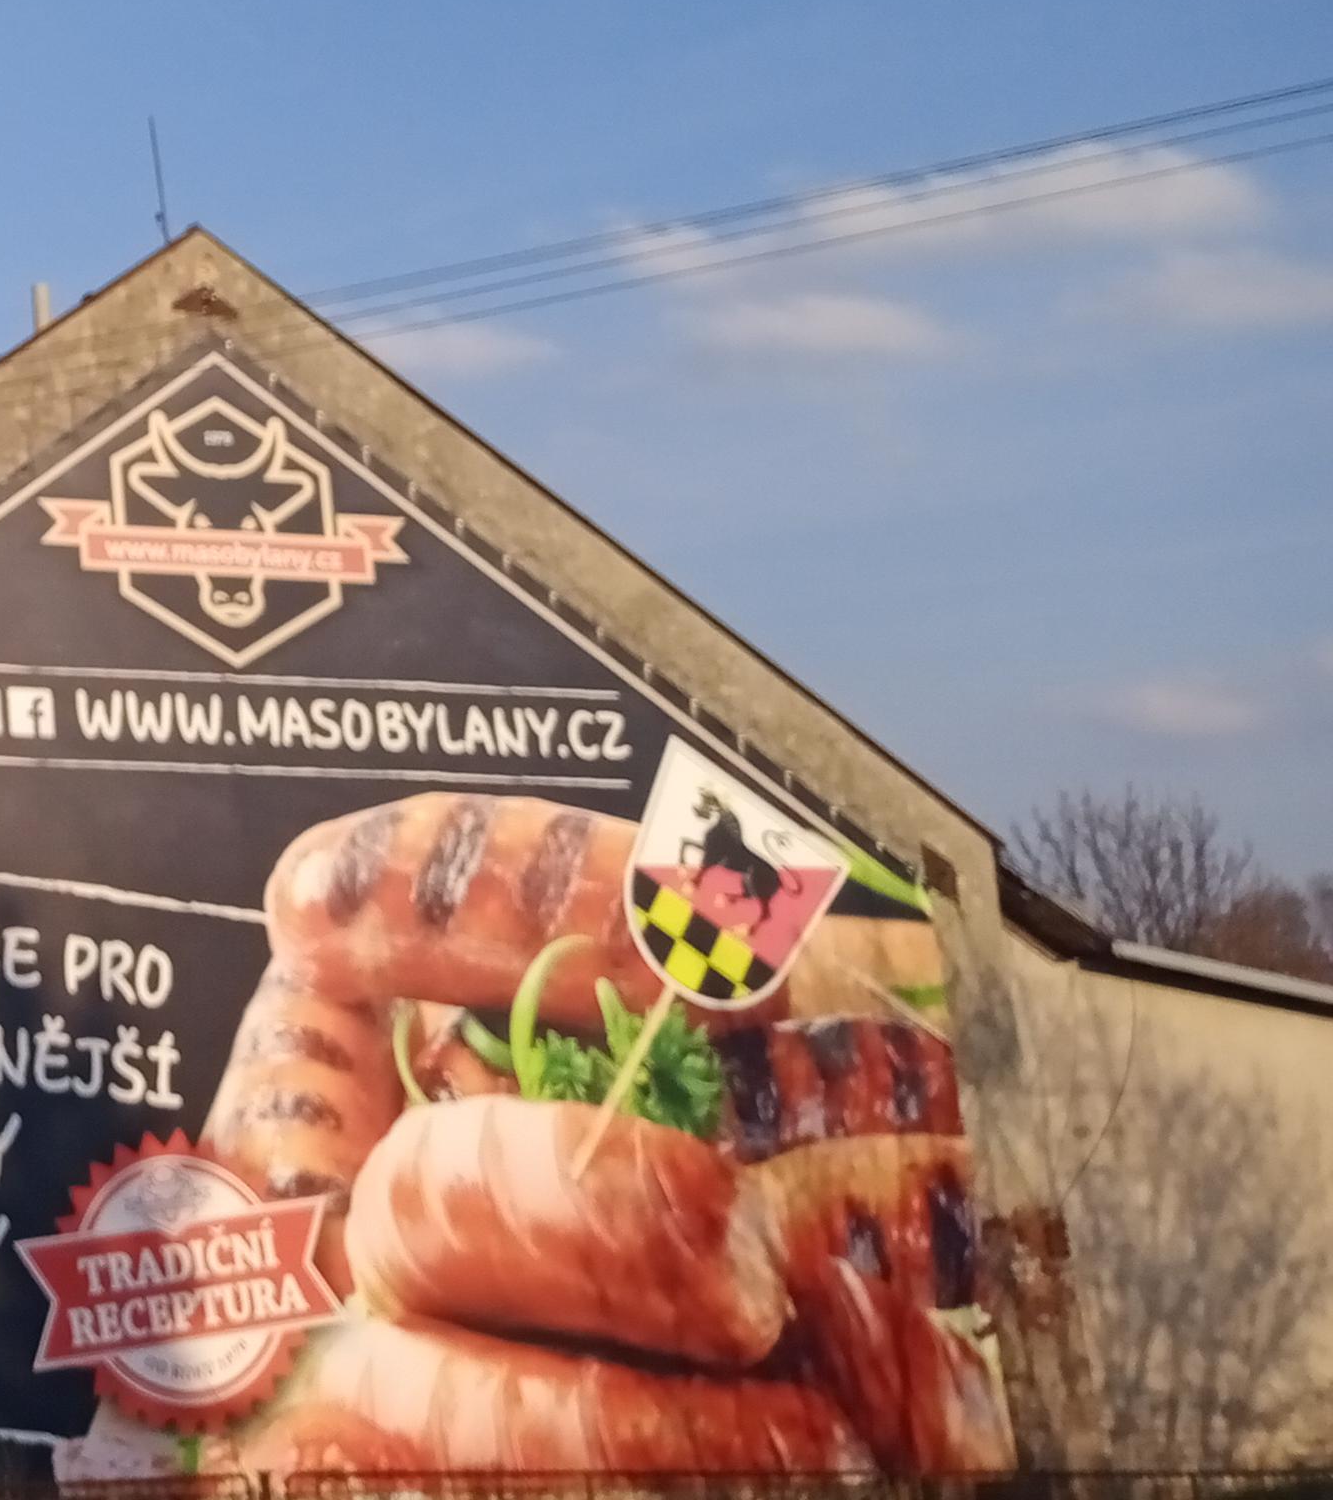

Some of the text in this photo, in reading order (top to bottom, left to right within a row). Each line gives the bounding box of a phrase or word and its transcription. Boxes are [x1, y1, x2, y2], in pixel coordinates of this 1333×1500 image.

[75, 687, 632, 763] WWW.MASOBYLANY.CZ
[64, 933, 173, 1008] PRO
[77, 1217, 281, 1297] TRADIČNÍ
[67, 1274, 310, 1350] RECEPTURA
